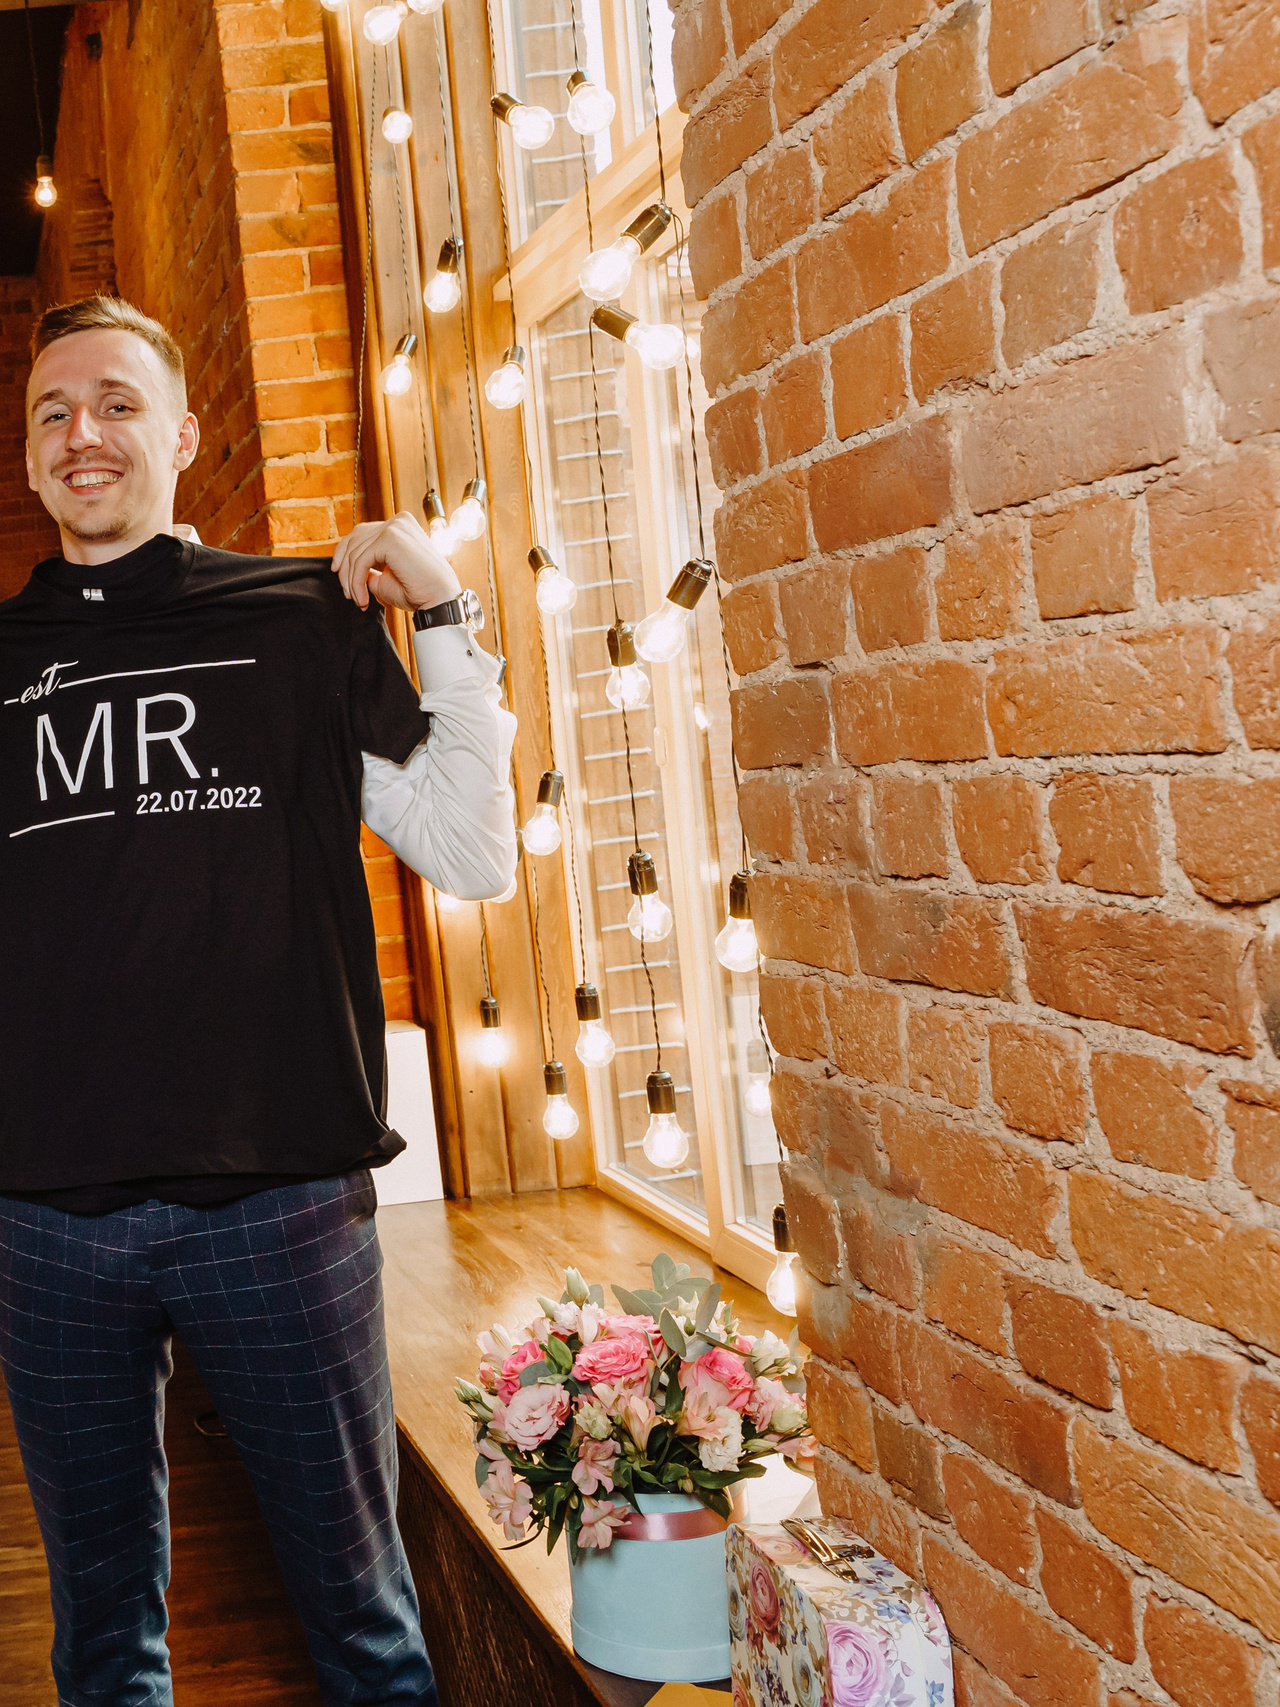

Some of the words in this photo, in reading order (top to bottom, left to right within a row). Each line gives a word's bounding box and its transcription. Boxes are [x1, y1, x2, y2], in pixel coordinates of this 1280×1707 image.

[20, 660, 79, 704] est
[36, 692, 219, 802] MR.
[135, 785, 263, 815] 22.07.2022
